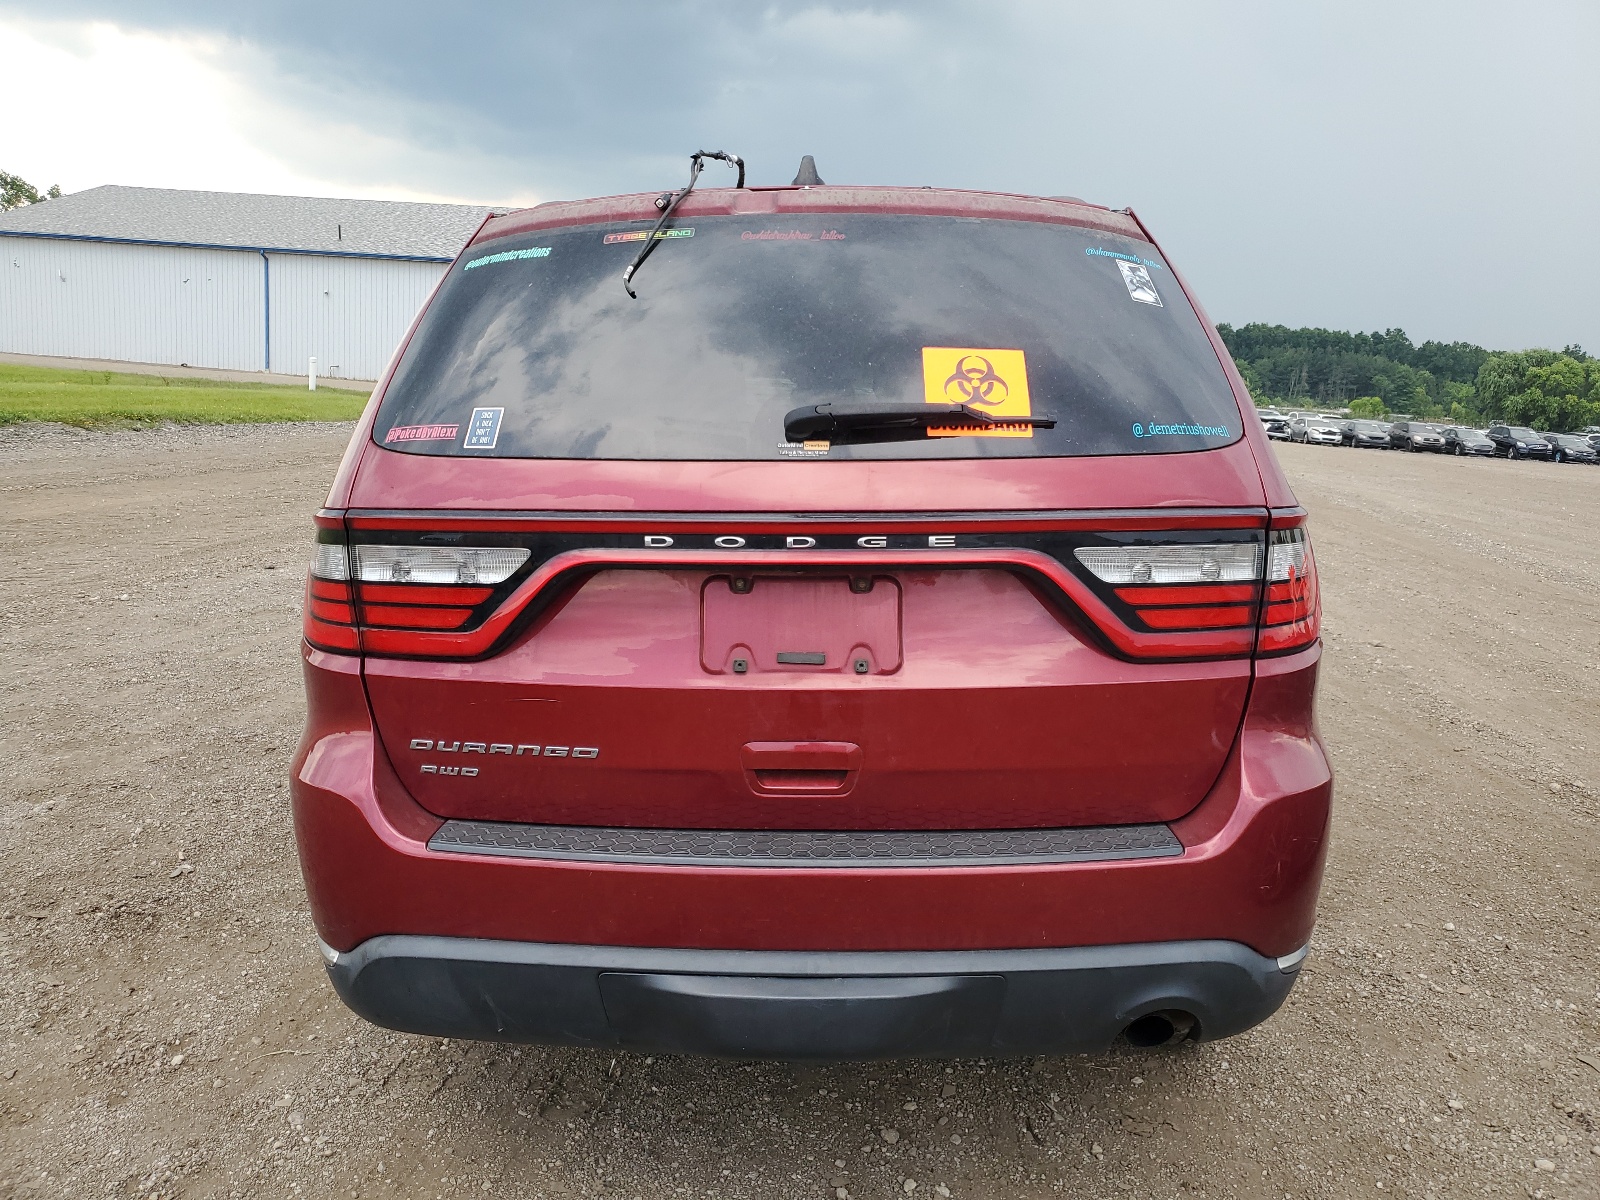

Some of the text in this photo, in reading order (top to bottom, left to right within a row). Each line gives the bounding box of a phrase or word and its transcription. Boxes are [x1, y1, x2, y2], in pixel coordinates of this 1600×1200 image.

[1132, 422, 1231, 438] @_demetriushowell
[644, 535, 956, 548] DODGE
[409, 738, 599, 759] DURANGO
[420, 765, 479, 777] AWD
